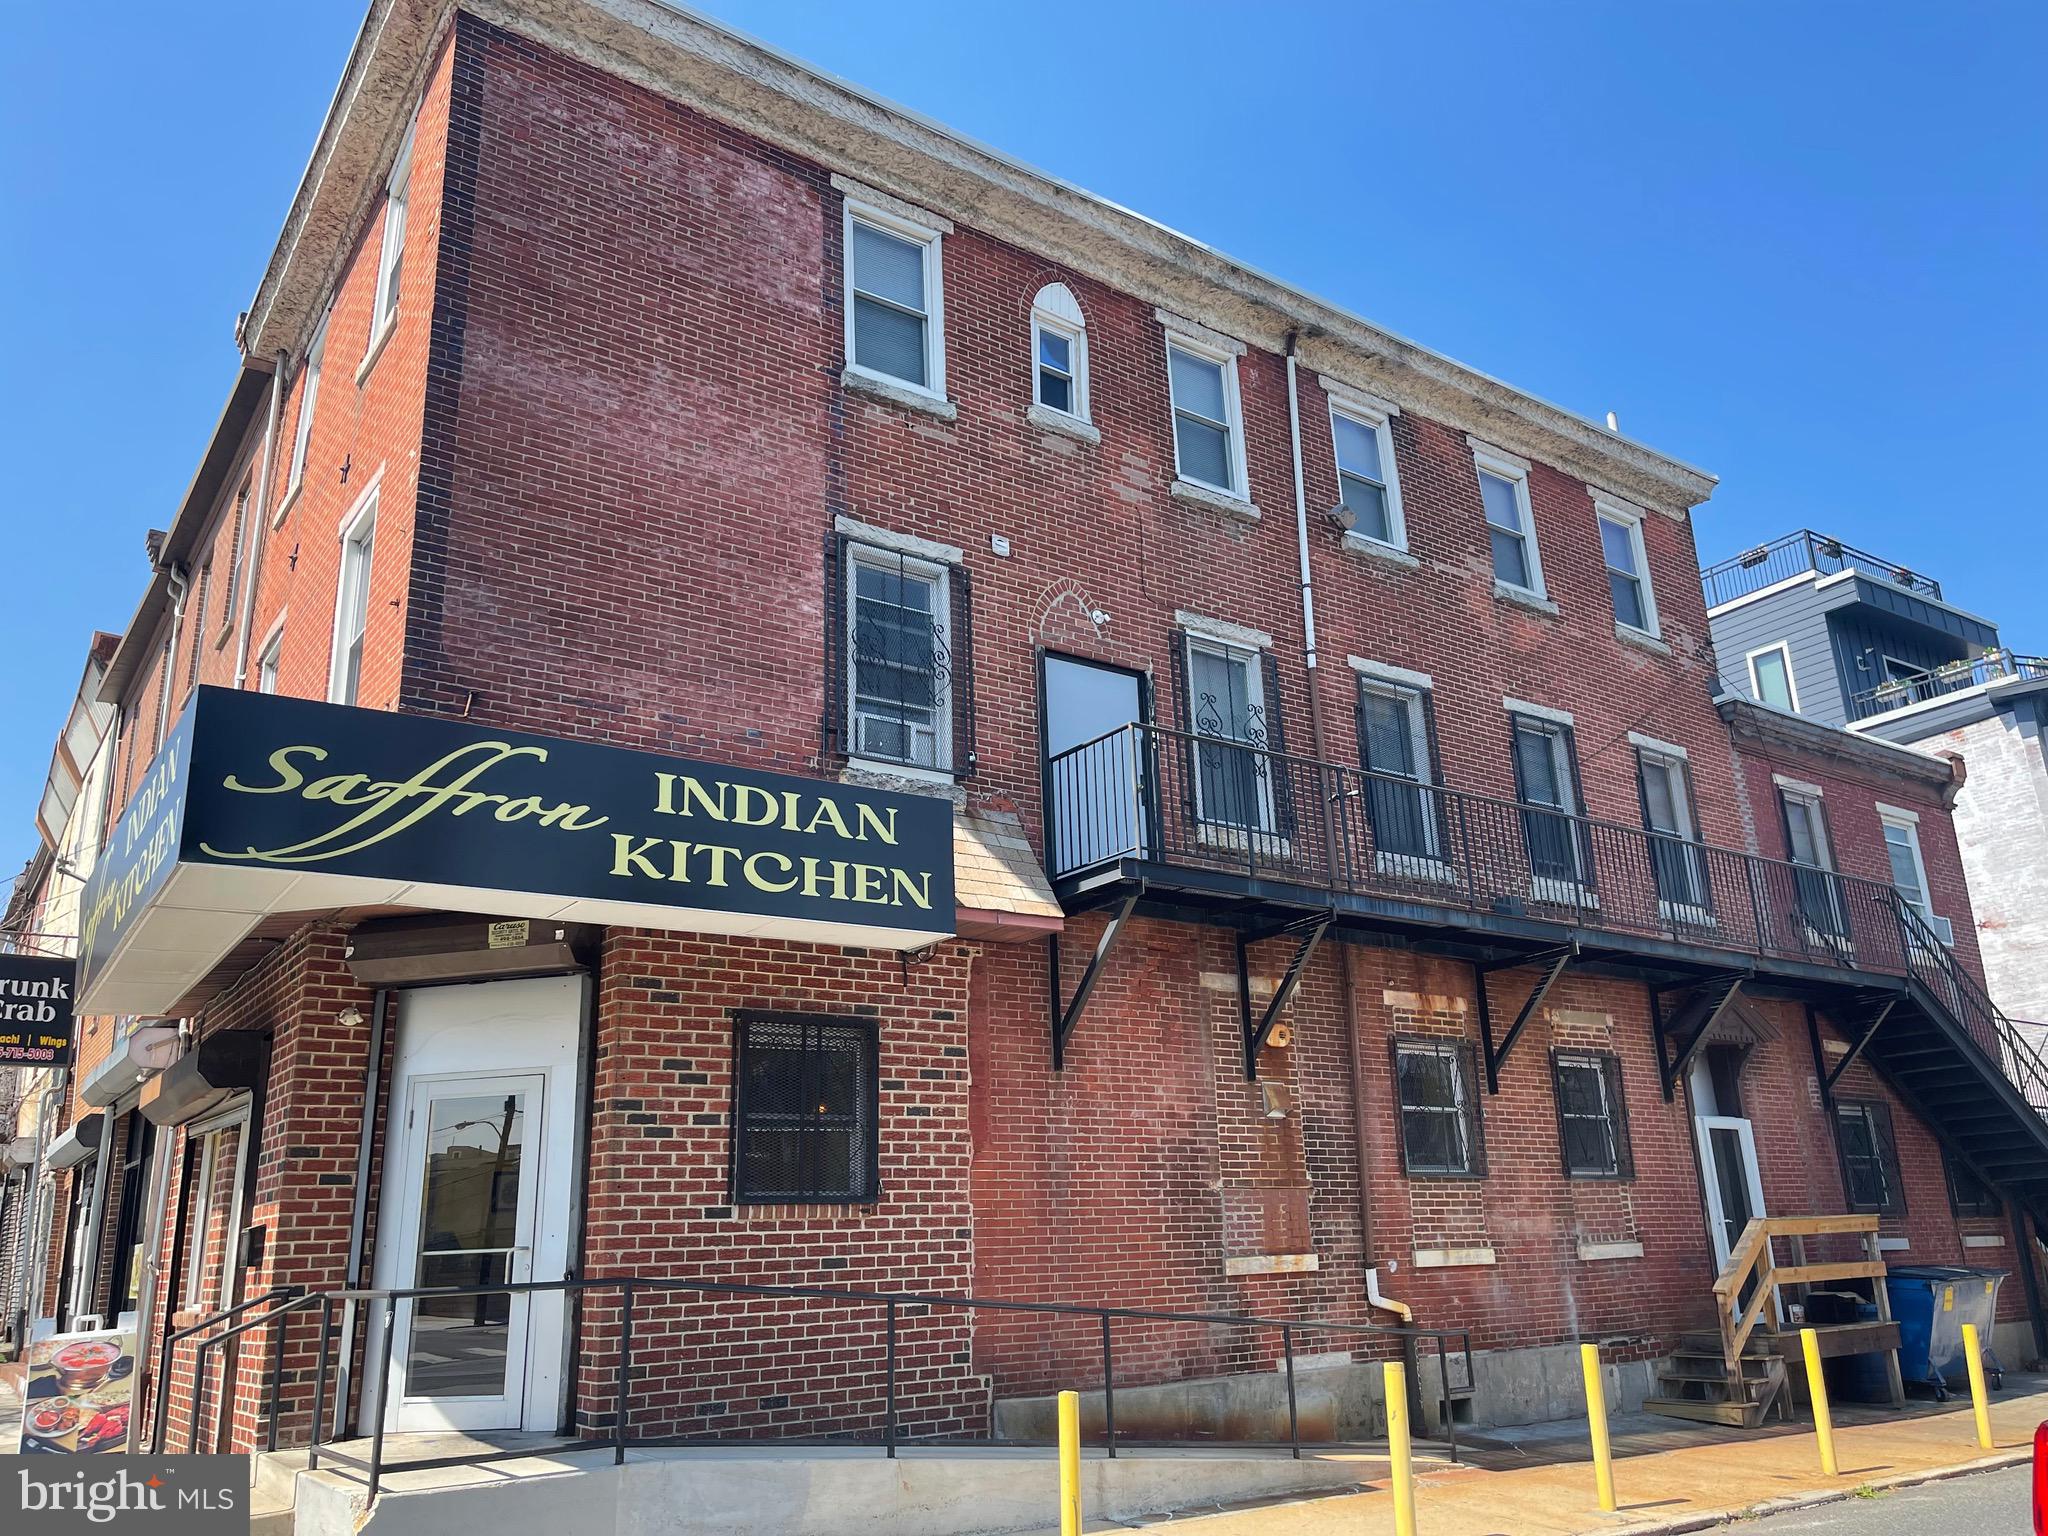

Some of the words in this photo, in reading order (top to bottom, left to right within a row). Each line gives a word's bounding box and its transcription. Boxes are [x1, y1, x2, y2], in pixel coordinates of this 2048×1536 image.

[125, 736, 181, 857] INDIAN
[200, 741, 609, 863] Saffron
[653, 771, 899, 846] INDIAN
[113, 797, 180, 932] KITCHEN
[608, 833, 933, 910] KITCHEN
[0, 977, 70, 1000] runk
[0, 1034, 20, 1044] achi
[39, 1035, 67, 1048] Wings
[0, 1046, 54, 1060] 5-715-5003
